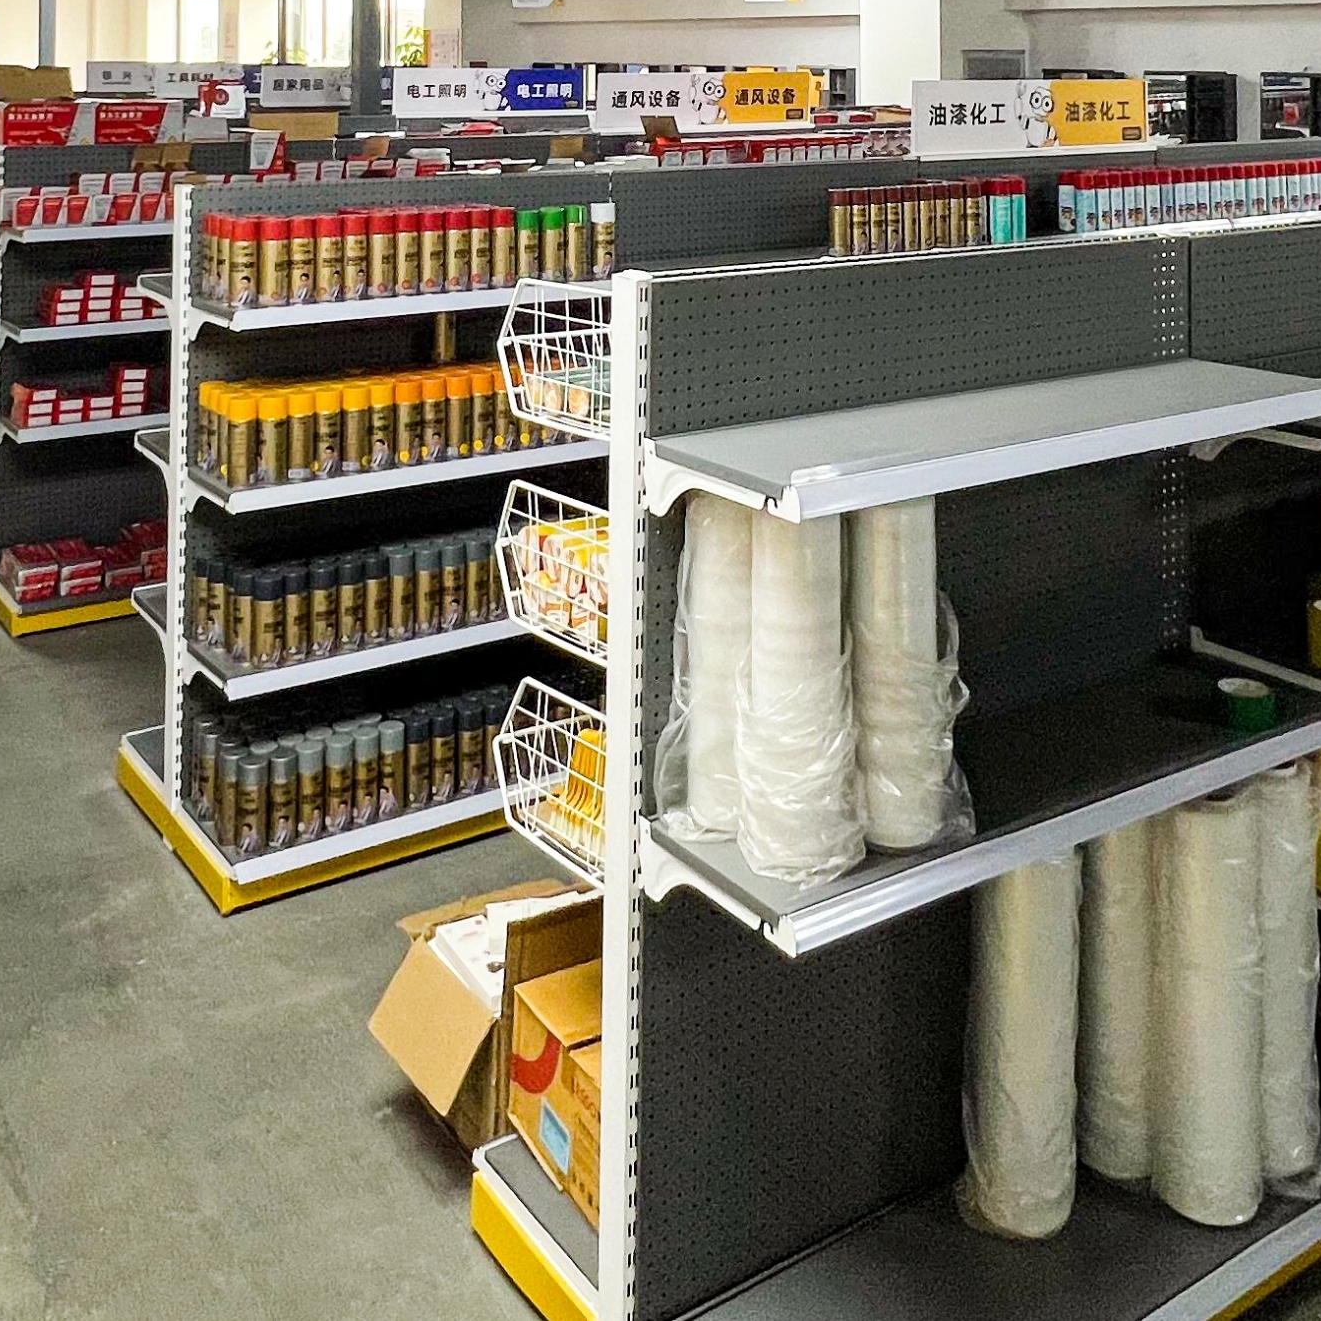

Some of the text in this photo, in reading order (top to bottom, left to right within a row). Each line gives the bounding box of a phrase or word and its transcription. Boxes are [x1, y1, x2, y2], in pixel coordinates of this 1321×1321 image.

[272, 78, 324, 91] 居家用品
[407, 84, 467, 98] 电工照明
[516, 83, 573, 99] 电工照明
[611, 90, 680, 108] 通风设备
[734, 88, 796, 106] 通风设备
[928, 102, 1006, 126] 油漆化工
[1065, 101, 1131, 122] 油漆化工
